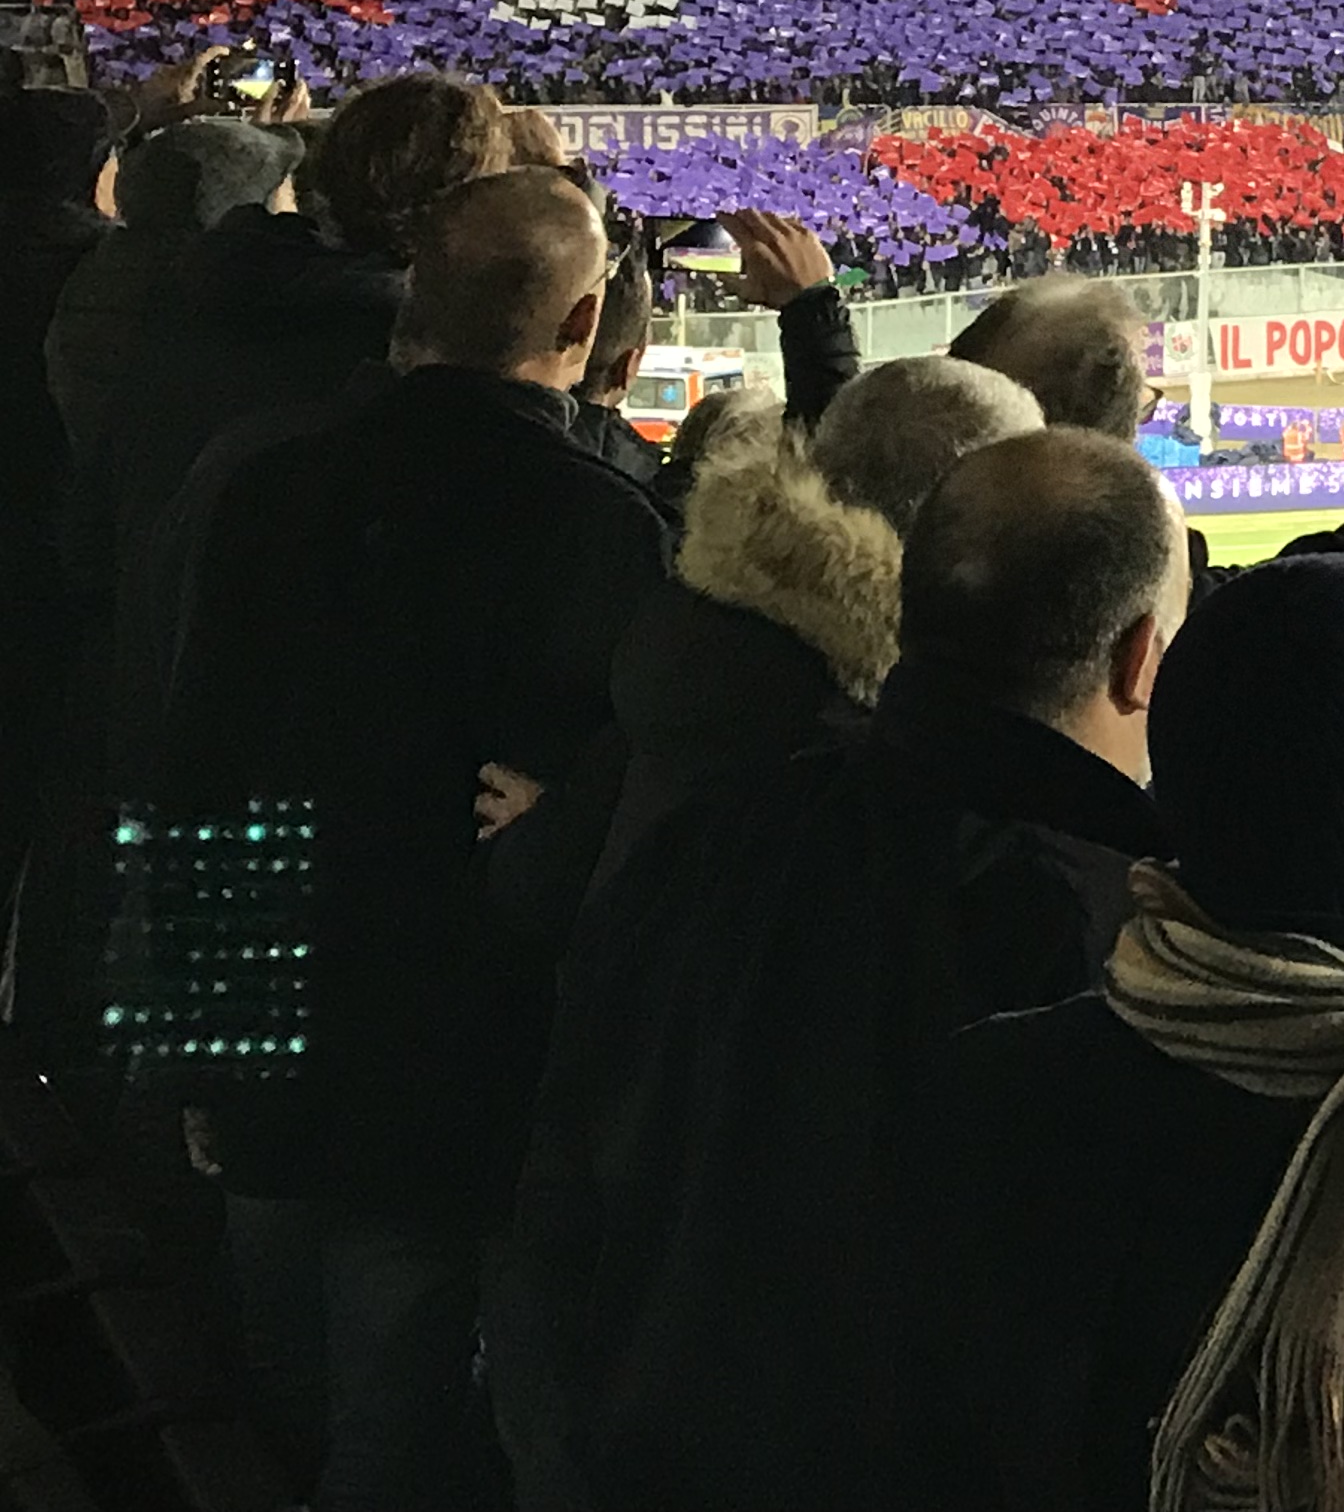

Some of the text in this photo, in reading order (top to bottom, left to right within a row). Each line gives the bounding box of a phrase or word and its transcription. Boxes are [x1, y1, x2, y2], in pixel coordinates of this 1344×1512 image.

[902, 109, 969, 129] VACILLO
[1220, 324, 1253, 370] IL
[1184, 473, 1314, 501] NSIEME
